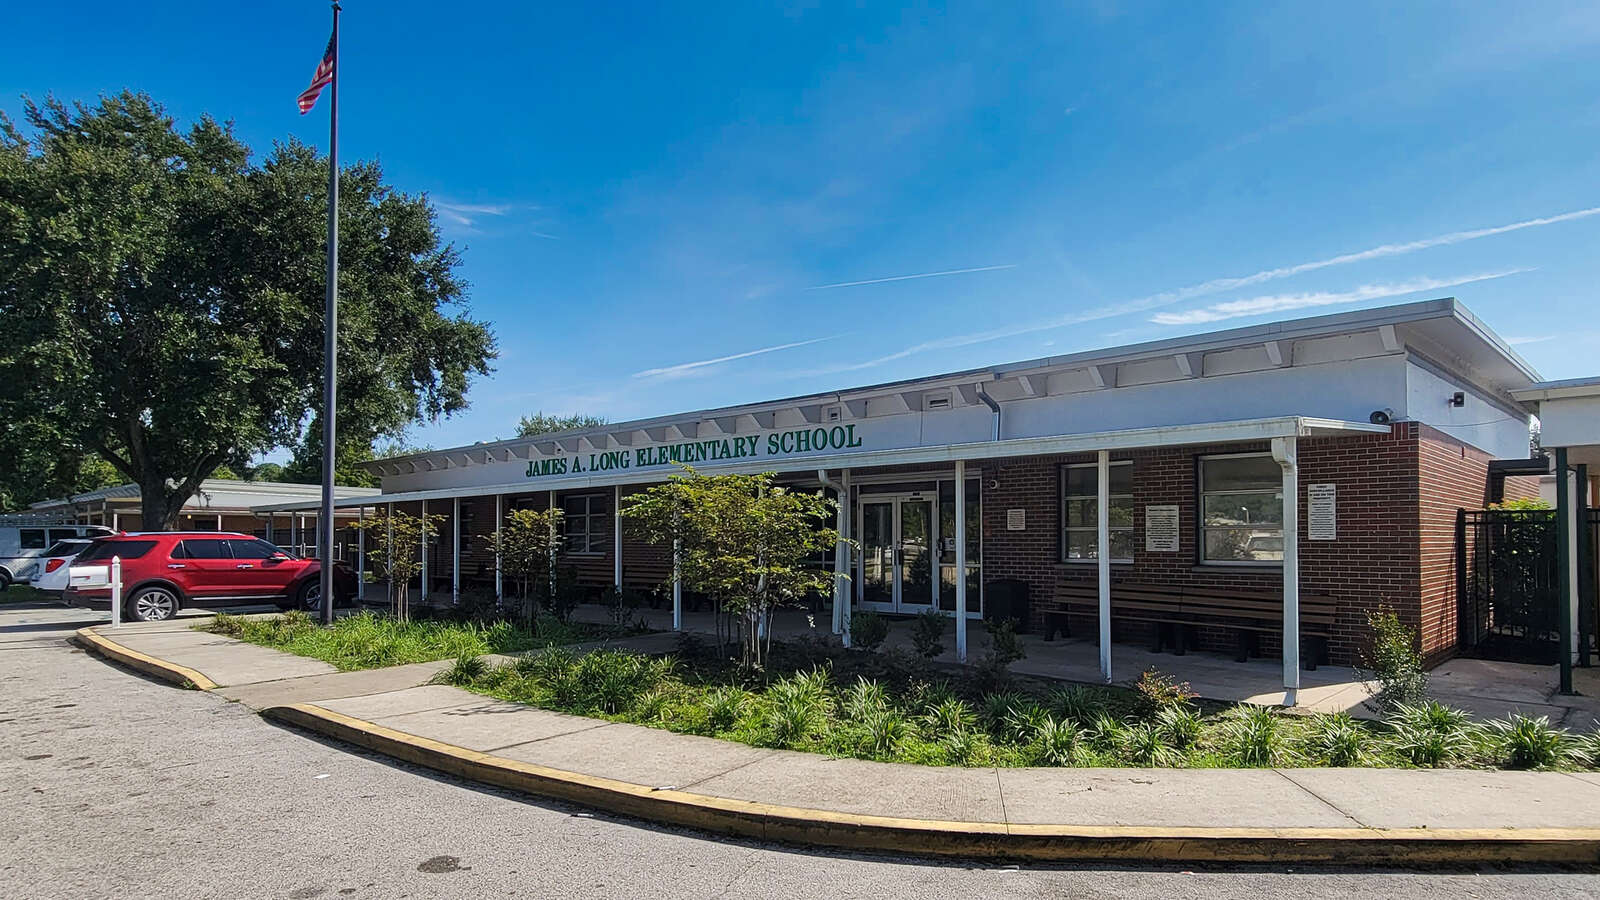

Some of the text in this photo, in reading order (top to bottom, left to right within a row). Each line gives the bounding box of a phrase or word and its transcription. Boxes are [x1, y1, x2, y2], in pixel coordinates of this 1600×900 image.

[526, 424, 862, 478] JAMES A. LONG ELEMENTARY SCHOOL
